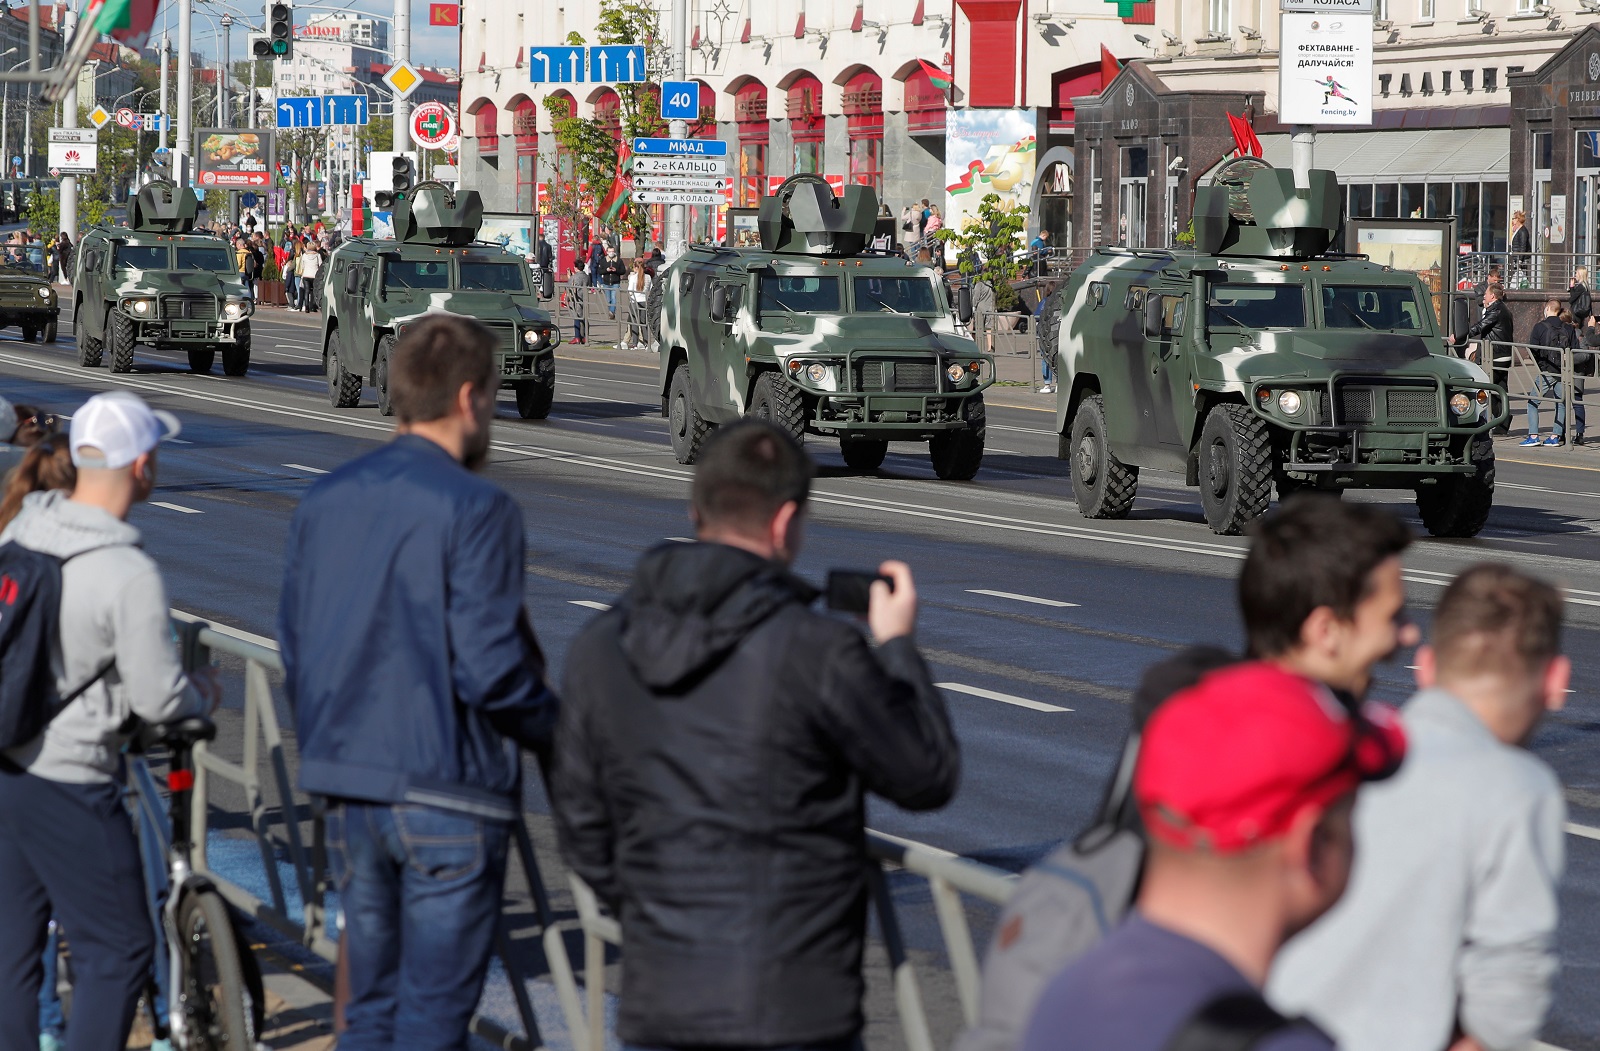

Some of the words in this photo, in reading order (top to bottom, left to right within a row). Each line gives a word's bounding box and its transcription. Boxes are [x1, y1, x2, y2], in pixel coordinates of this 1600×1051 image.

[1298, 44, 1354, 52] ФЕХТАВАННЕ
[1298, 58, 1354, 68] ДАЛУЧАЙСЯ!
[669, 92, 691, 108] 40
[1321, 109, 1357, 117] Fencing.by
[669, 141, 704, 153] МКАД
[653, 160, 668, 171] 2-е
[669, 161, 717, 174] КАЛЬЦО
[982, 144, 1033, 192] 75
[656, 195, 670, 203] вул.
